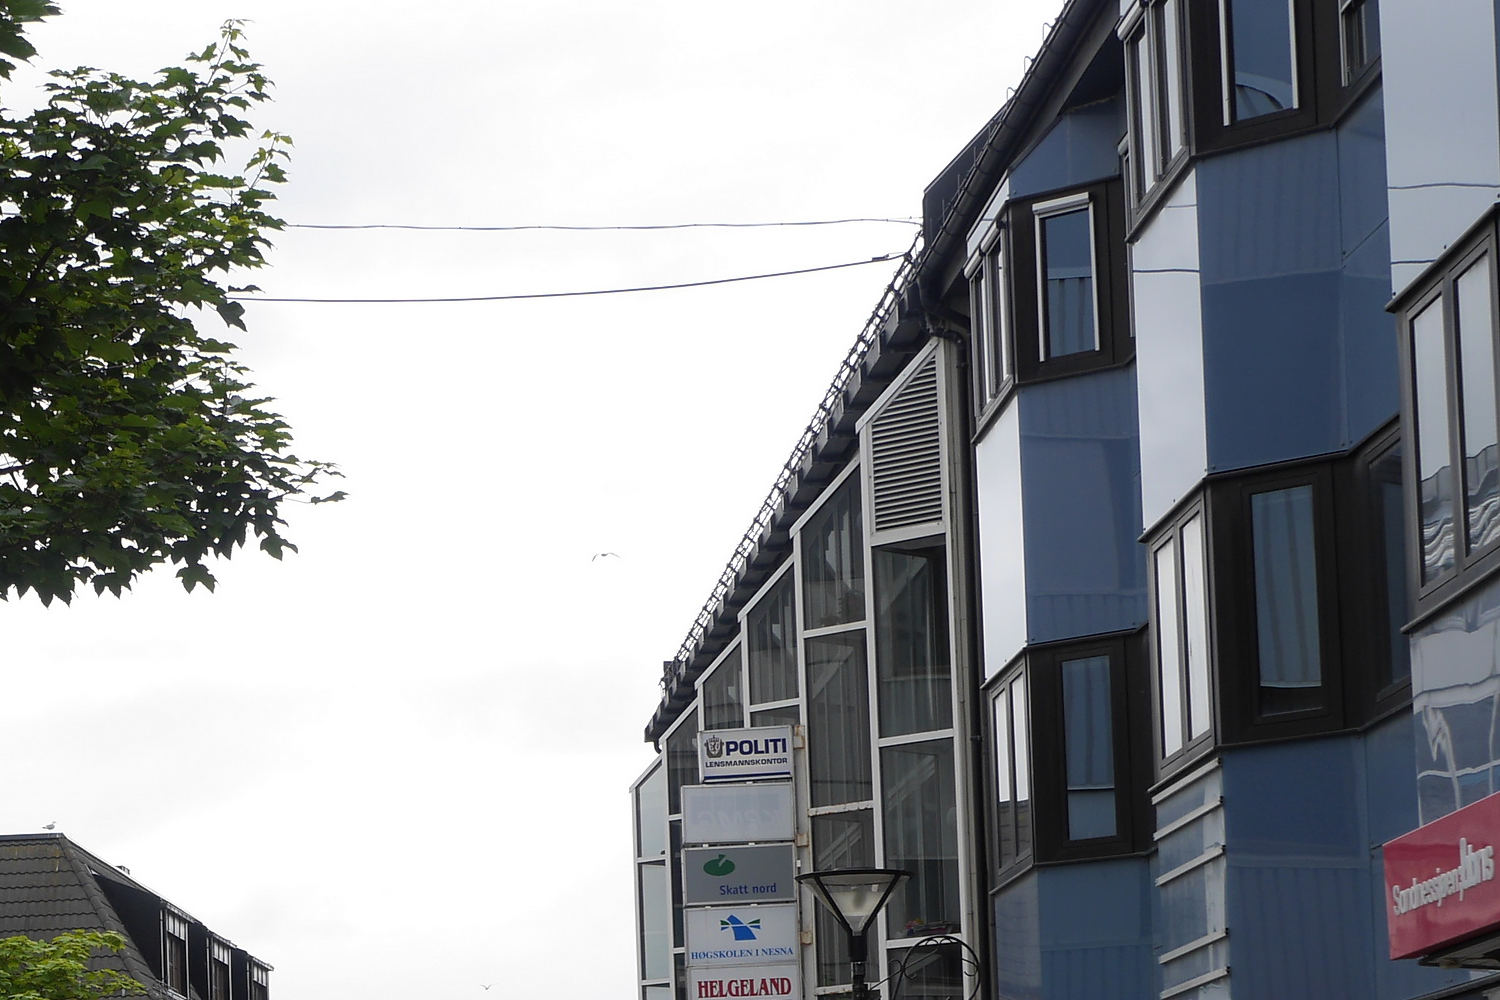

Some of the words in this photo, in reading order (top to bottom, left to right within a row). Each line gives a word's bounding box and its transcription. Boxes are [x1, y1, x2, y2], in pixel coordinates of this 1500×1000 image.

[725, 738, 787, 756] POLITI
[705, 757, 788, 768] LENSMANNSKONTOR
[719, 884, 749, 896] Skatt
[752, 883, 777, 894] nord
[690, 949, 753, 960] HØGSKOLEN
[755, 948, 760, 957] I
[761, 947, 794, 957] NESNA
[697, 977, 792, 999] HELGELAND
